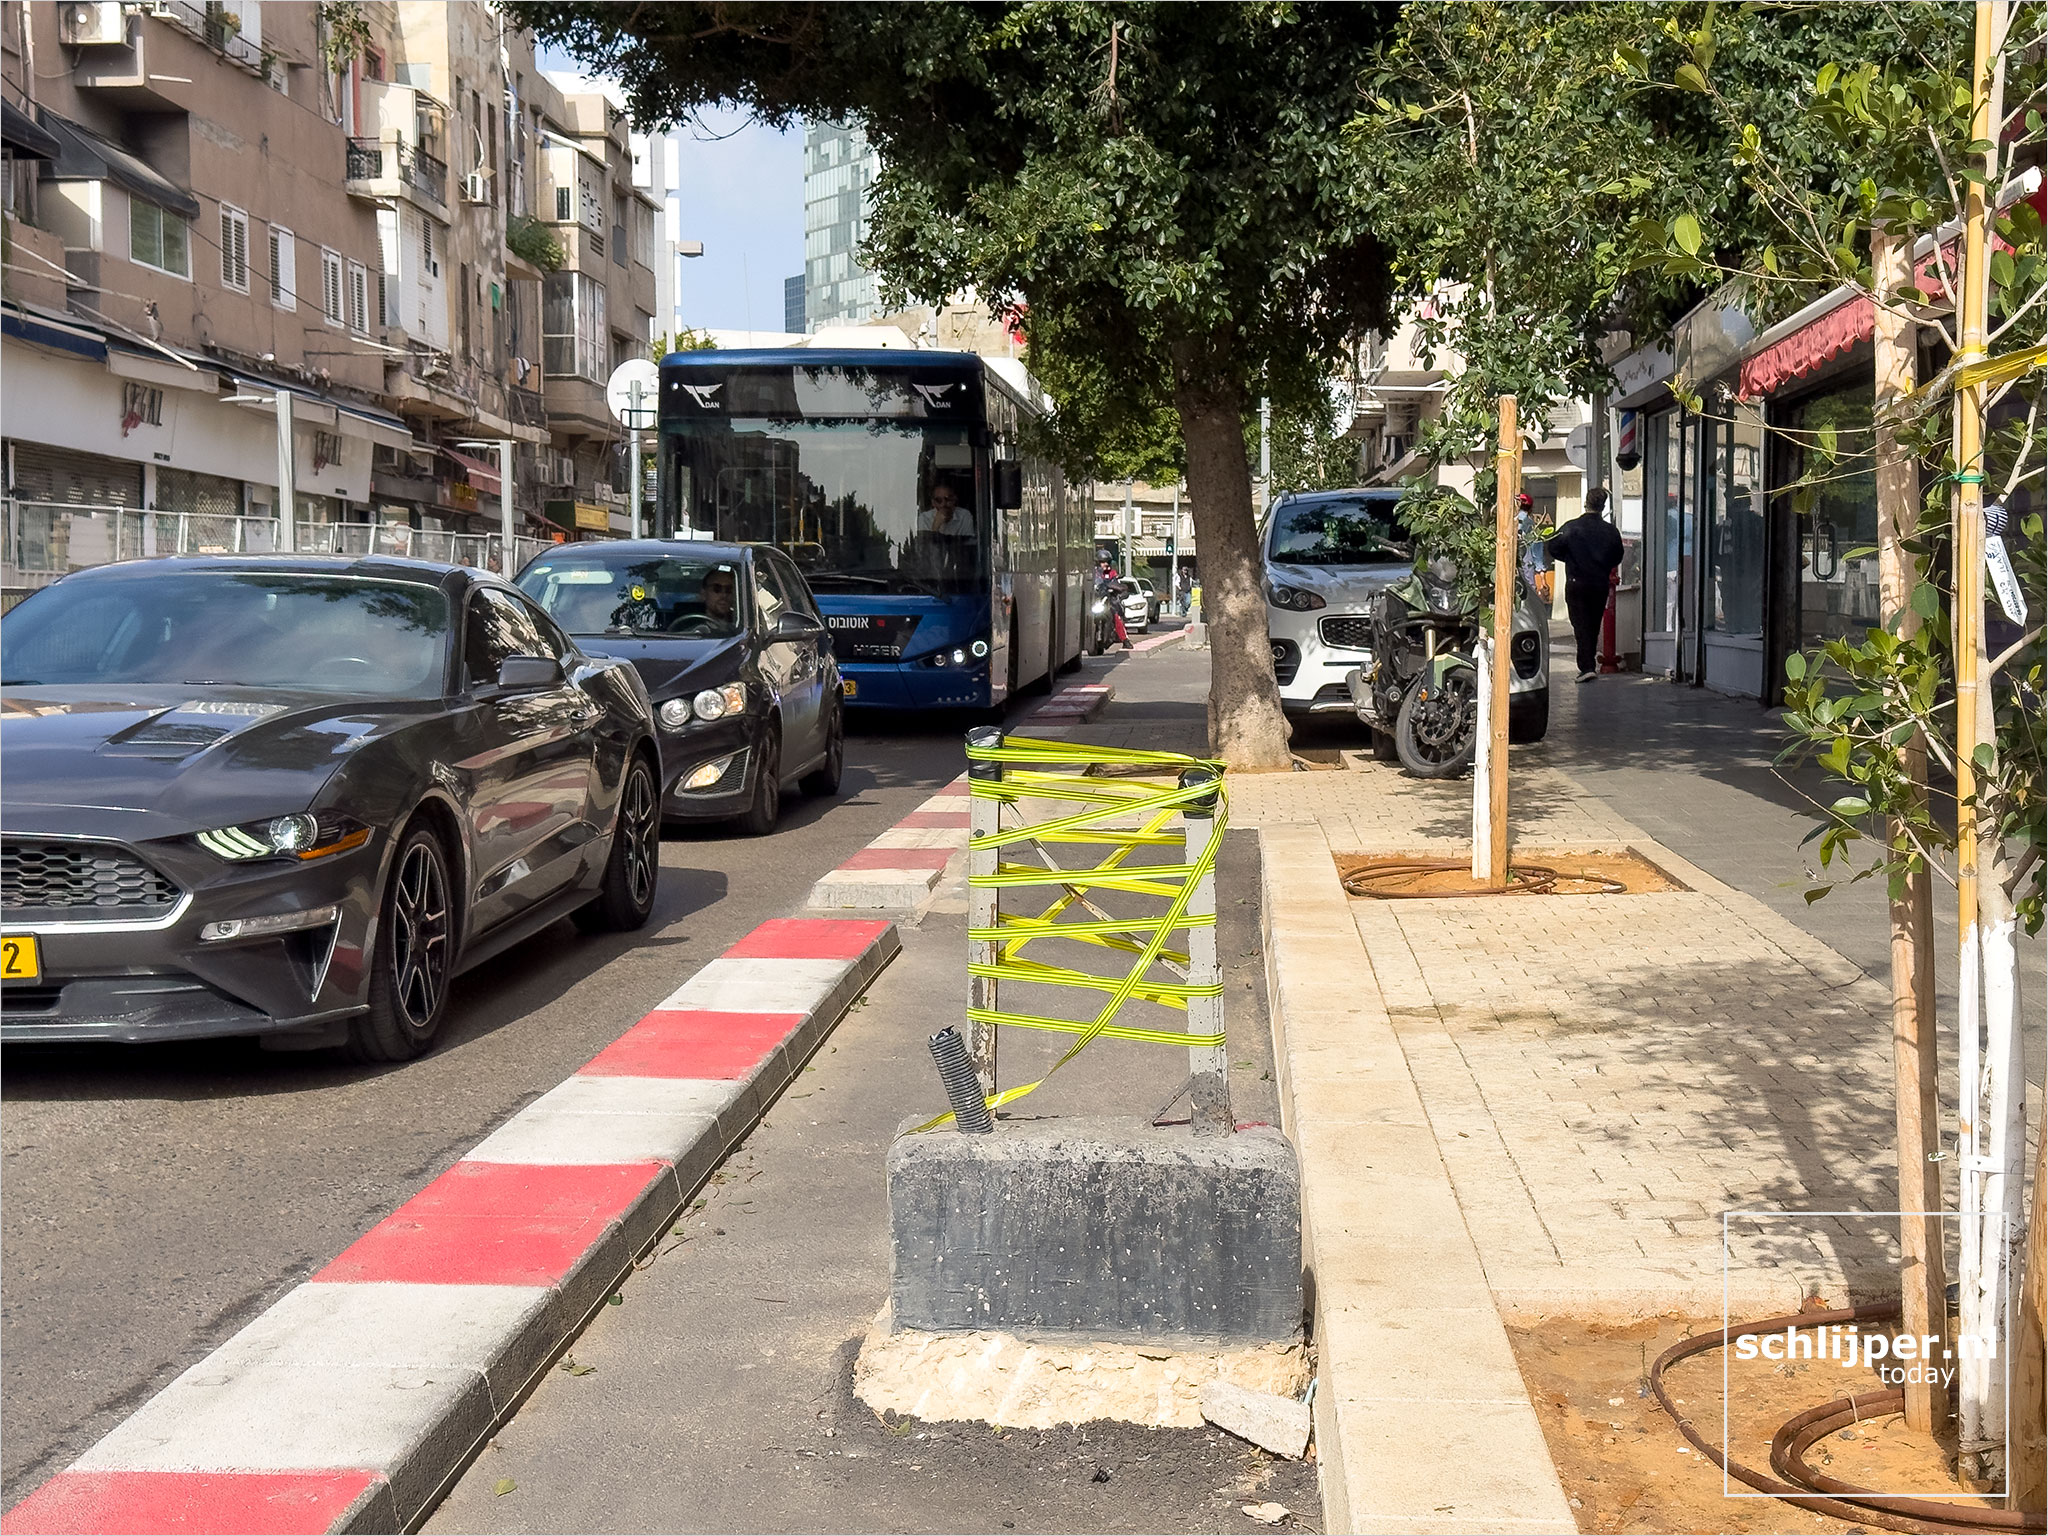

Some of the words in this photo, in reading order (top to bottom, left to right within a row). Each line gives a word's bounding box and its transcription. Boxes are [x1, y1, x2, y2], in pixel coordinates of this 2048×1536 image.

[705, 401, 720, 409] DAN
[936, 401, 951, 409] DAN
[828, 617, 869, 629] אוטובוס
[853, 644, 901, 657] HIGER
